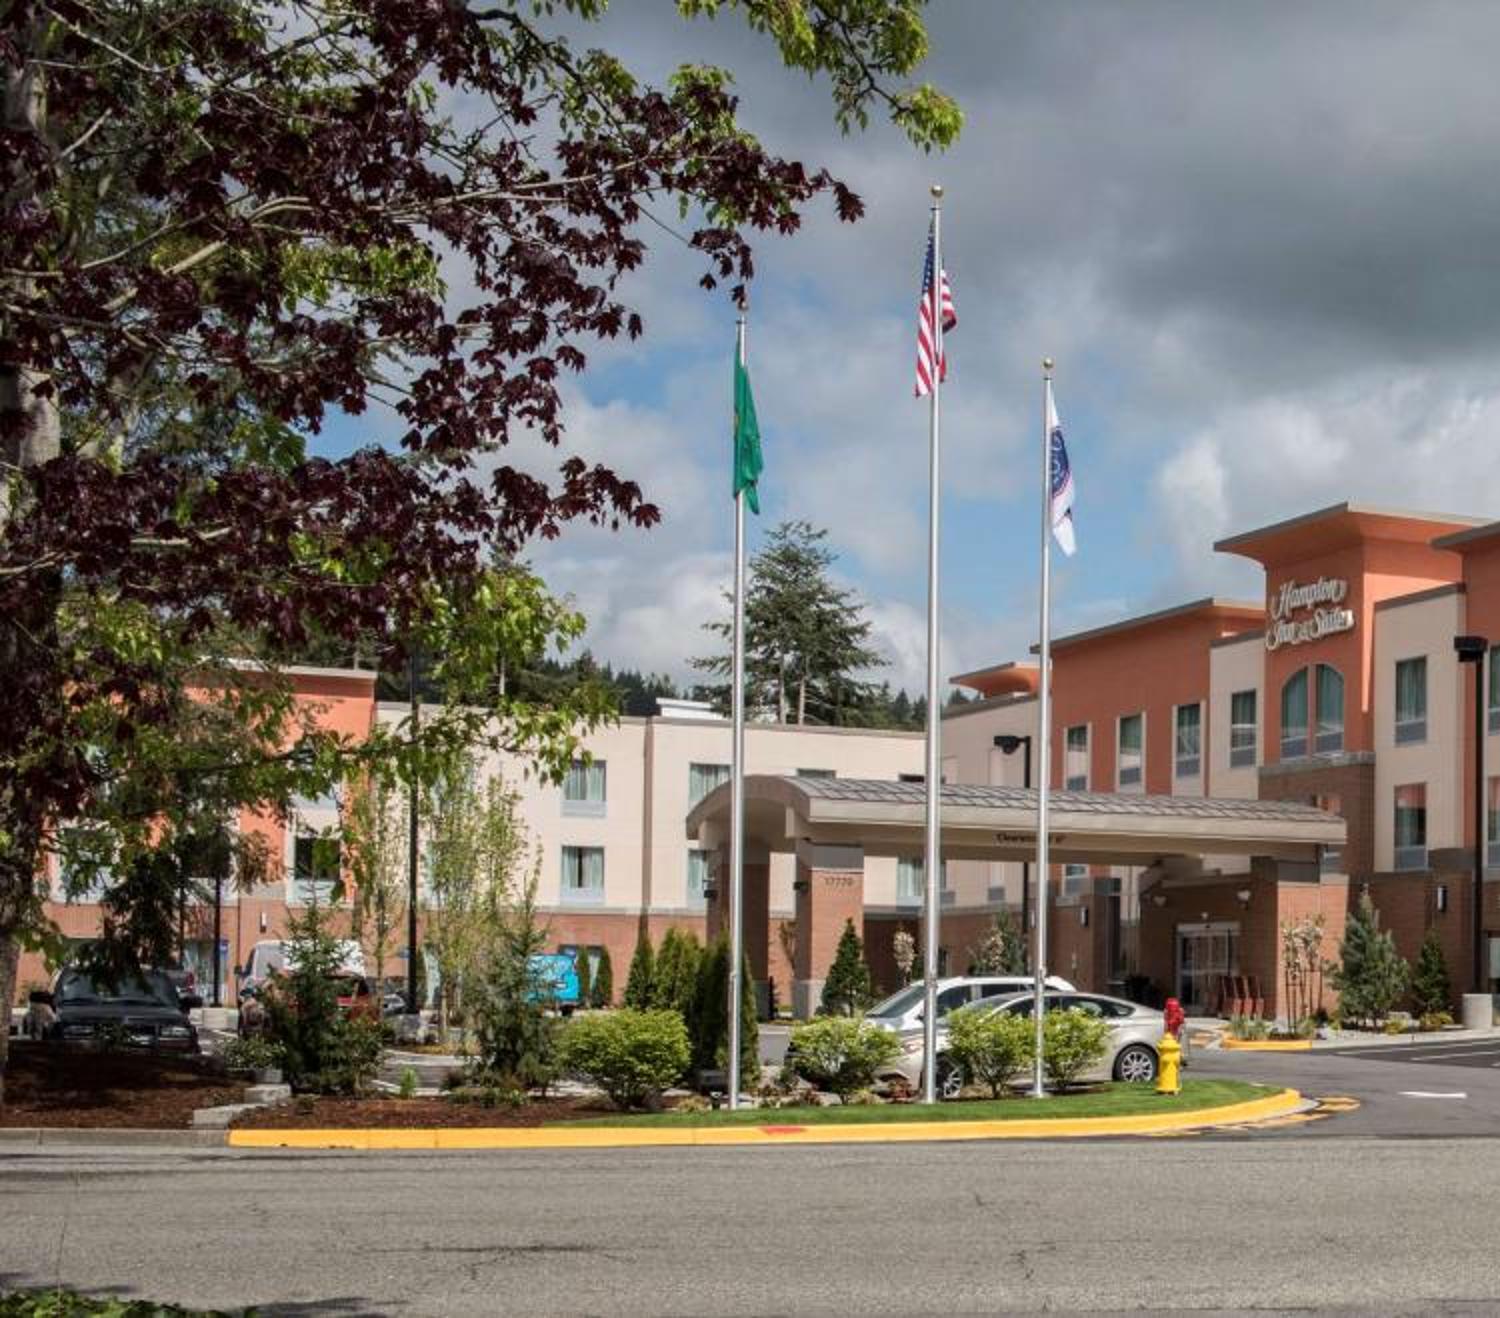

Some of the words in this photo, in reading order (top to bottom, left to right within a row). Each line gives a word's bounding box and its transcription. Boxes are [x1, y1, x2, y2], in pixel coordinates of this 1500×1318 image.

[1270, 576, 1347, 620] Hampton
[1265, 619, 1301, 650] Inn
[1311, 605, 1354, 638] Suites
